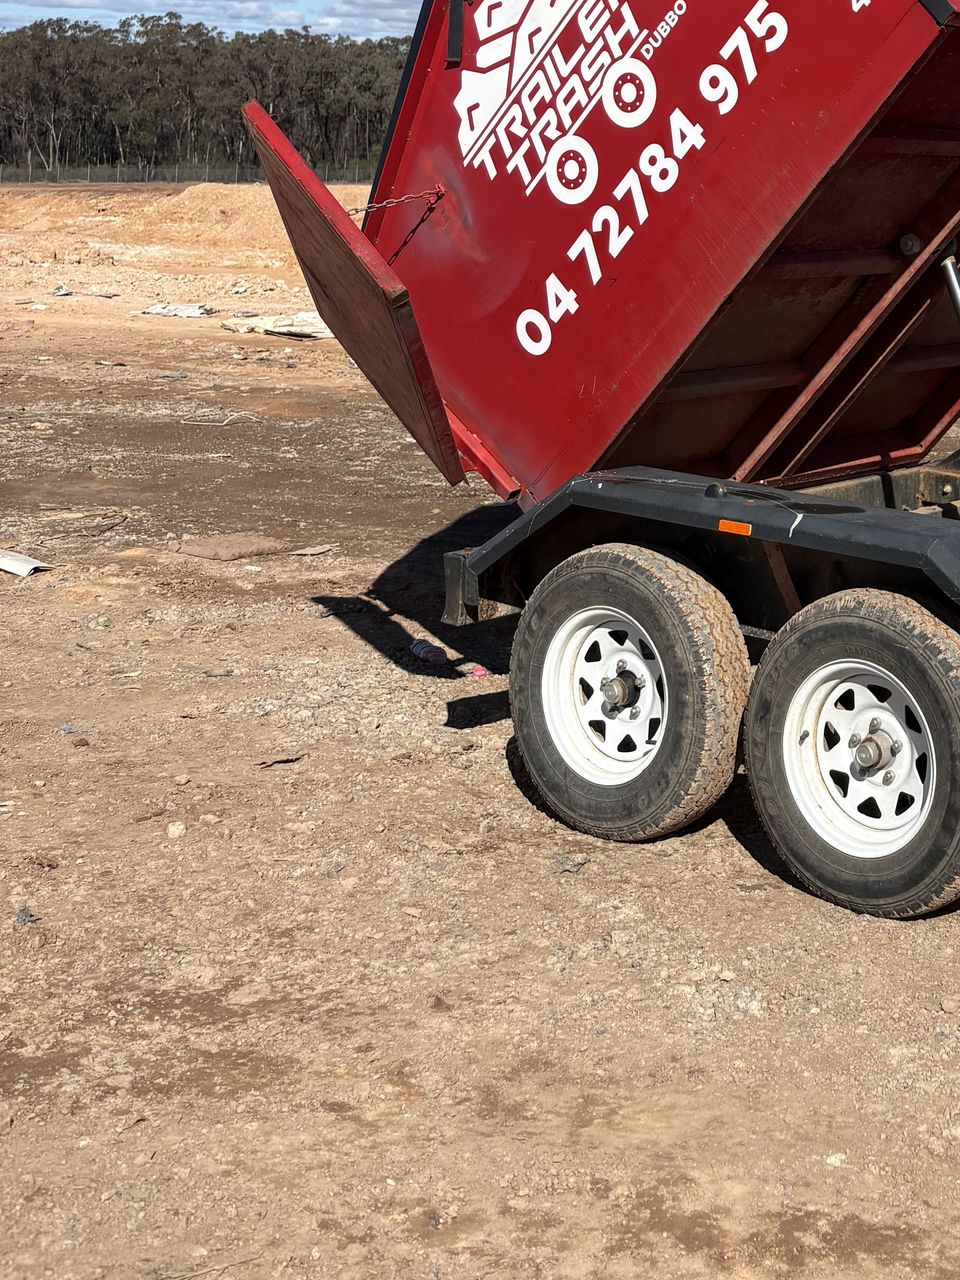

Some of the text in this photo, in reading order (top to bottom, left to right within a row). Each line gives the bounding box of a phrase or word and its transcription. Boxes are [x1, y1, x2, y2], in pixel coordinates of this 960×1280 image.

[506, 1, 640, 185] TRASH
[516, 272, 580, 356] 04
[567, 107, 706, 286] 72784
